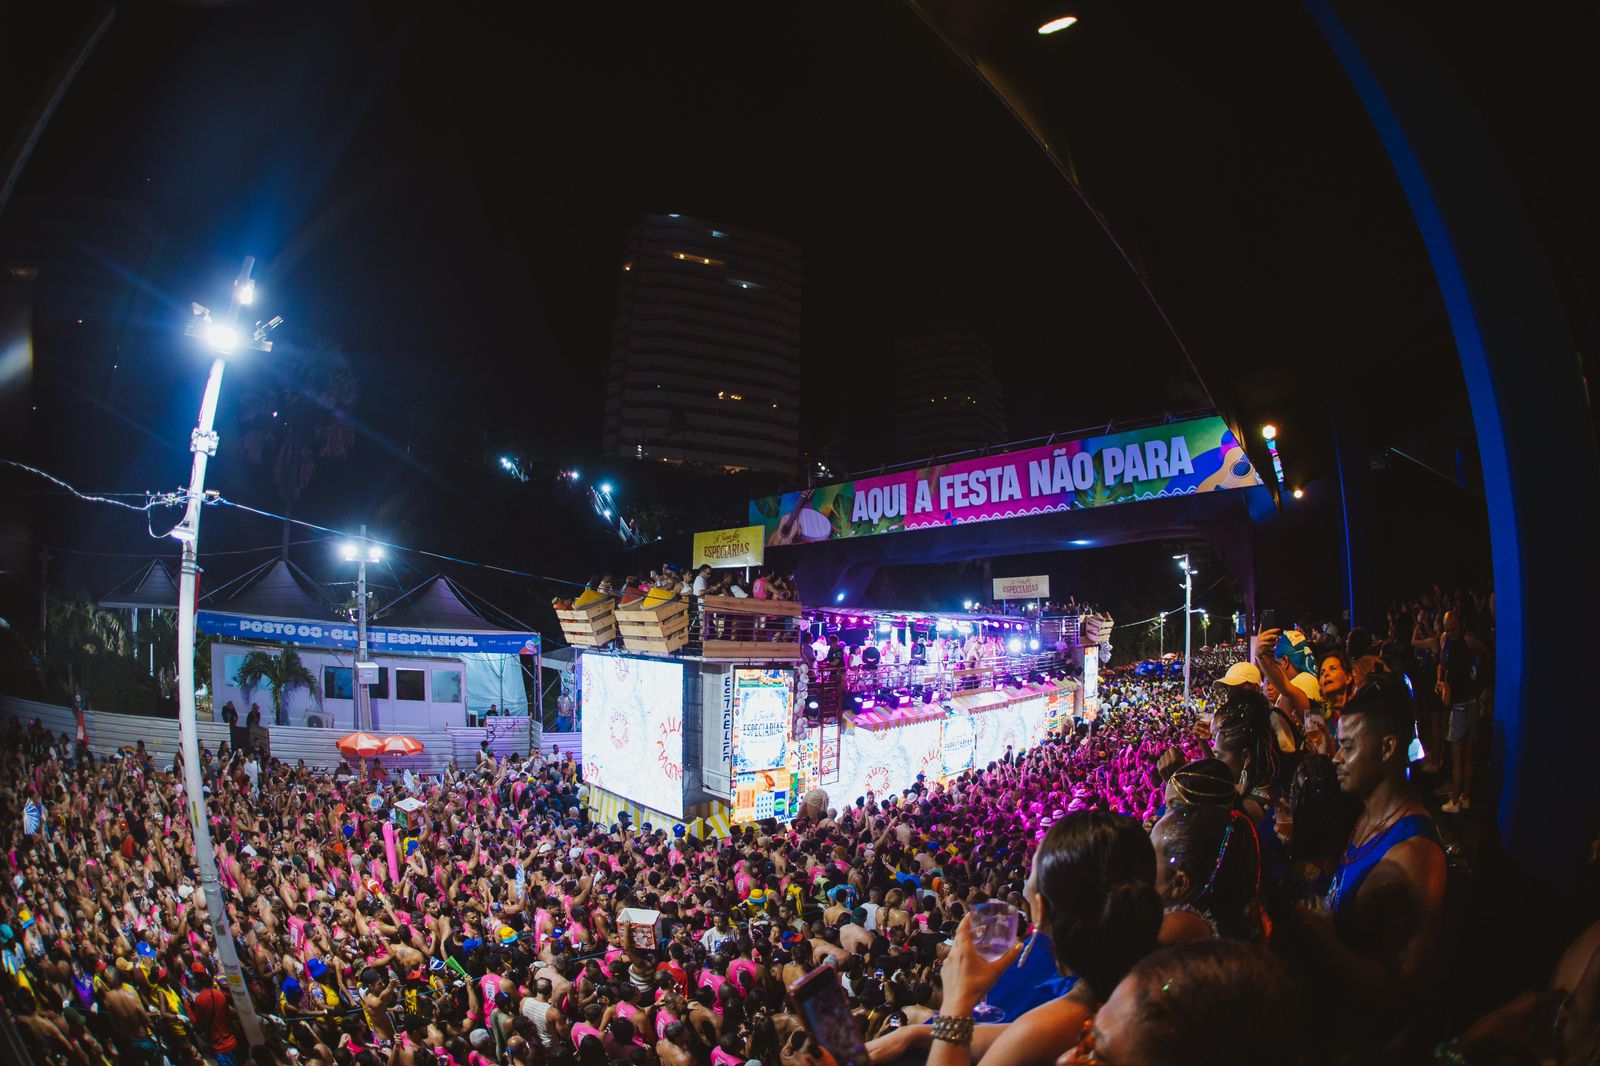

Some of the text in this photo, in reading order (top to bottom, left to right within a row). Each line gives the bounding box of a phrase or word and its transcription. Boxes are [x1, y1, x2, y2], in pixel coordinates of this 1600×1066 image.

[852, 436, 1194, 524] AQUI A FESTA NÃO PARA
[704, 543, 749, 558] ESPECIARIAS
[240, 620, 296, 635] POSTO
[387, 632, 478, 647] ESPANHOL
